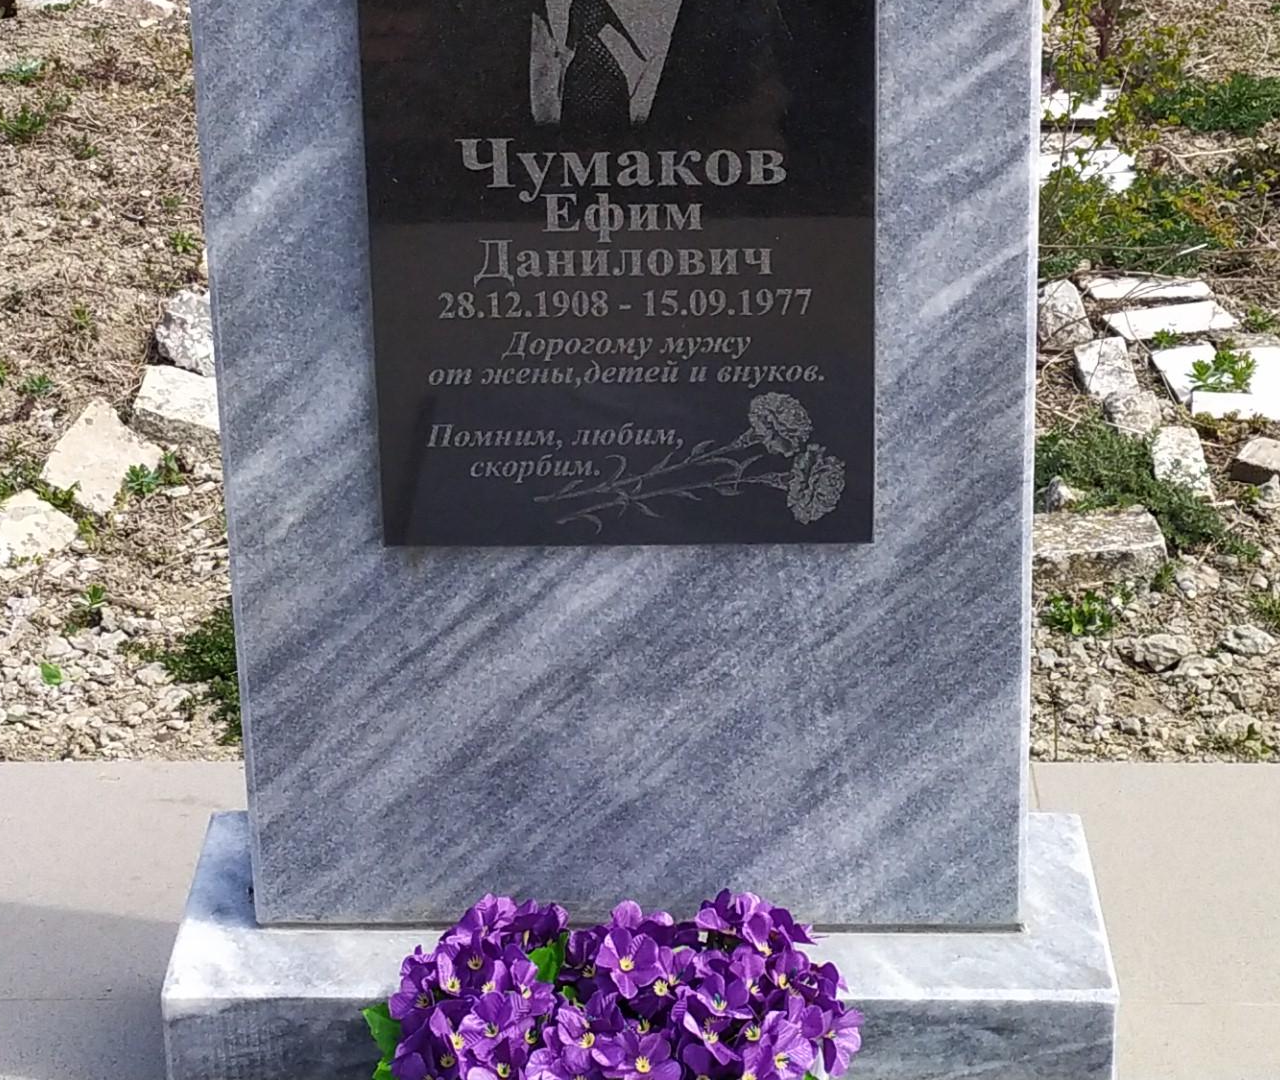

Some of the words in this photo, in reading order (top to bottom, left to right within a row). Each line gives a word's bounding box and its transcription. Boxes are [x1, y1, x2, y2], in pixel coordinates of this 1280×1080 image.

[455, 137, 788, 202] Чумаков
[541, 193, 704, 243] Ефим
[473, 239, 774, 287] Данилович
[437, 289, 609, 319] 28.12.1908
[643, 288, 813, 317] 15.09.1977
[501, 332, 653, 362] Дорогому
[660, 334, 752, 360] мужу
[428, 366, 472, 386] от
[688, 365, 708, 384] и
[716, 361, 826, 388] внуков.
[426, 423, 564, 450] Помним,
[571, 421, 686, 449] любим,
[470, 455, 601, 483] скорбим.
